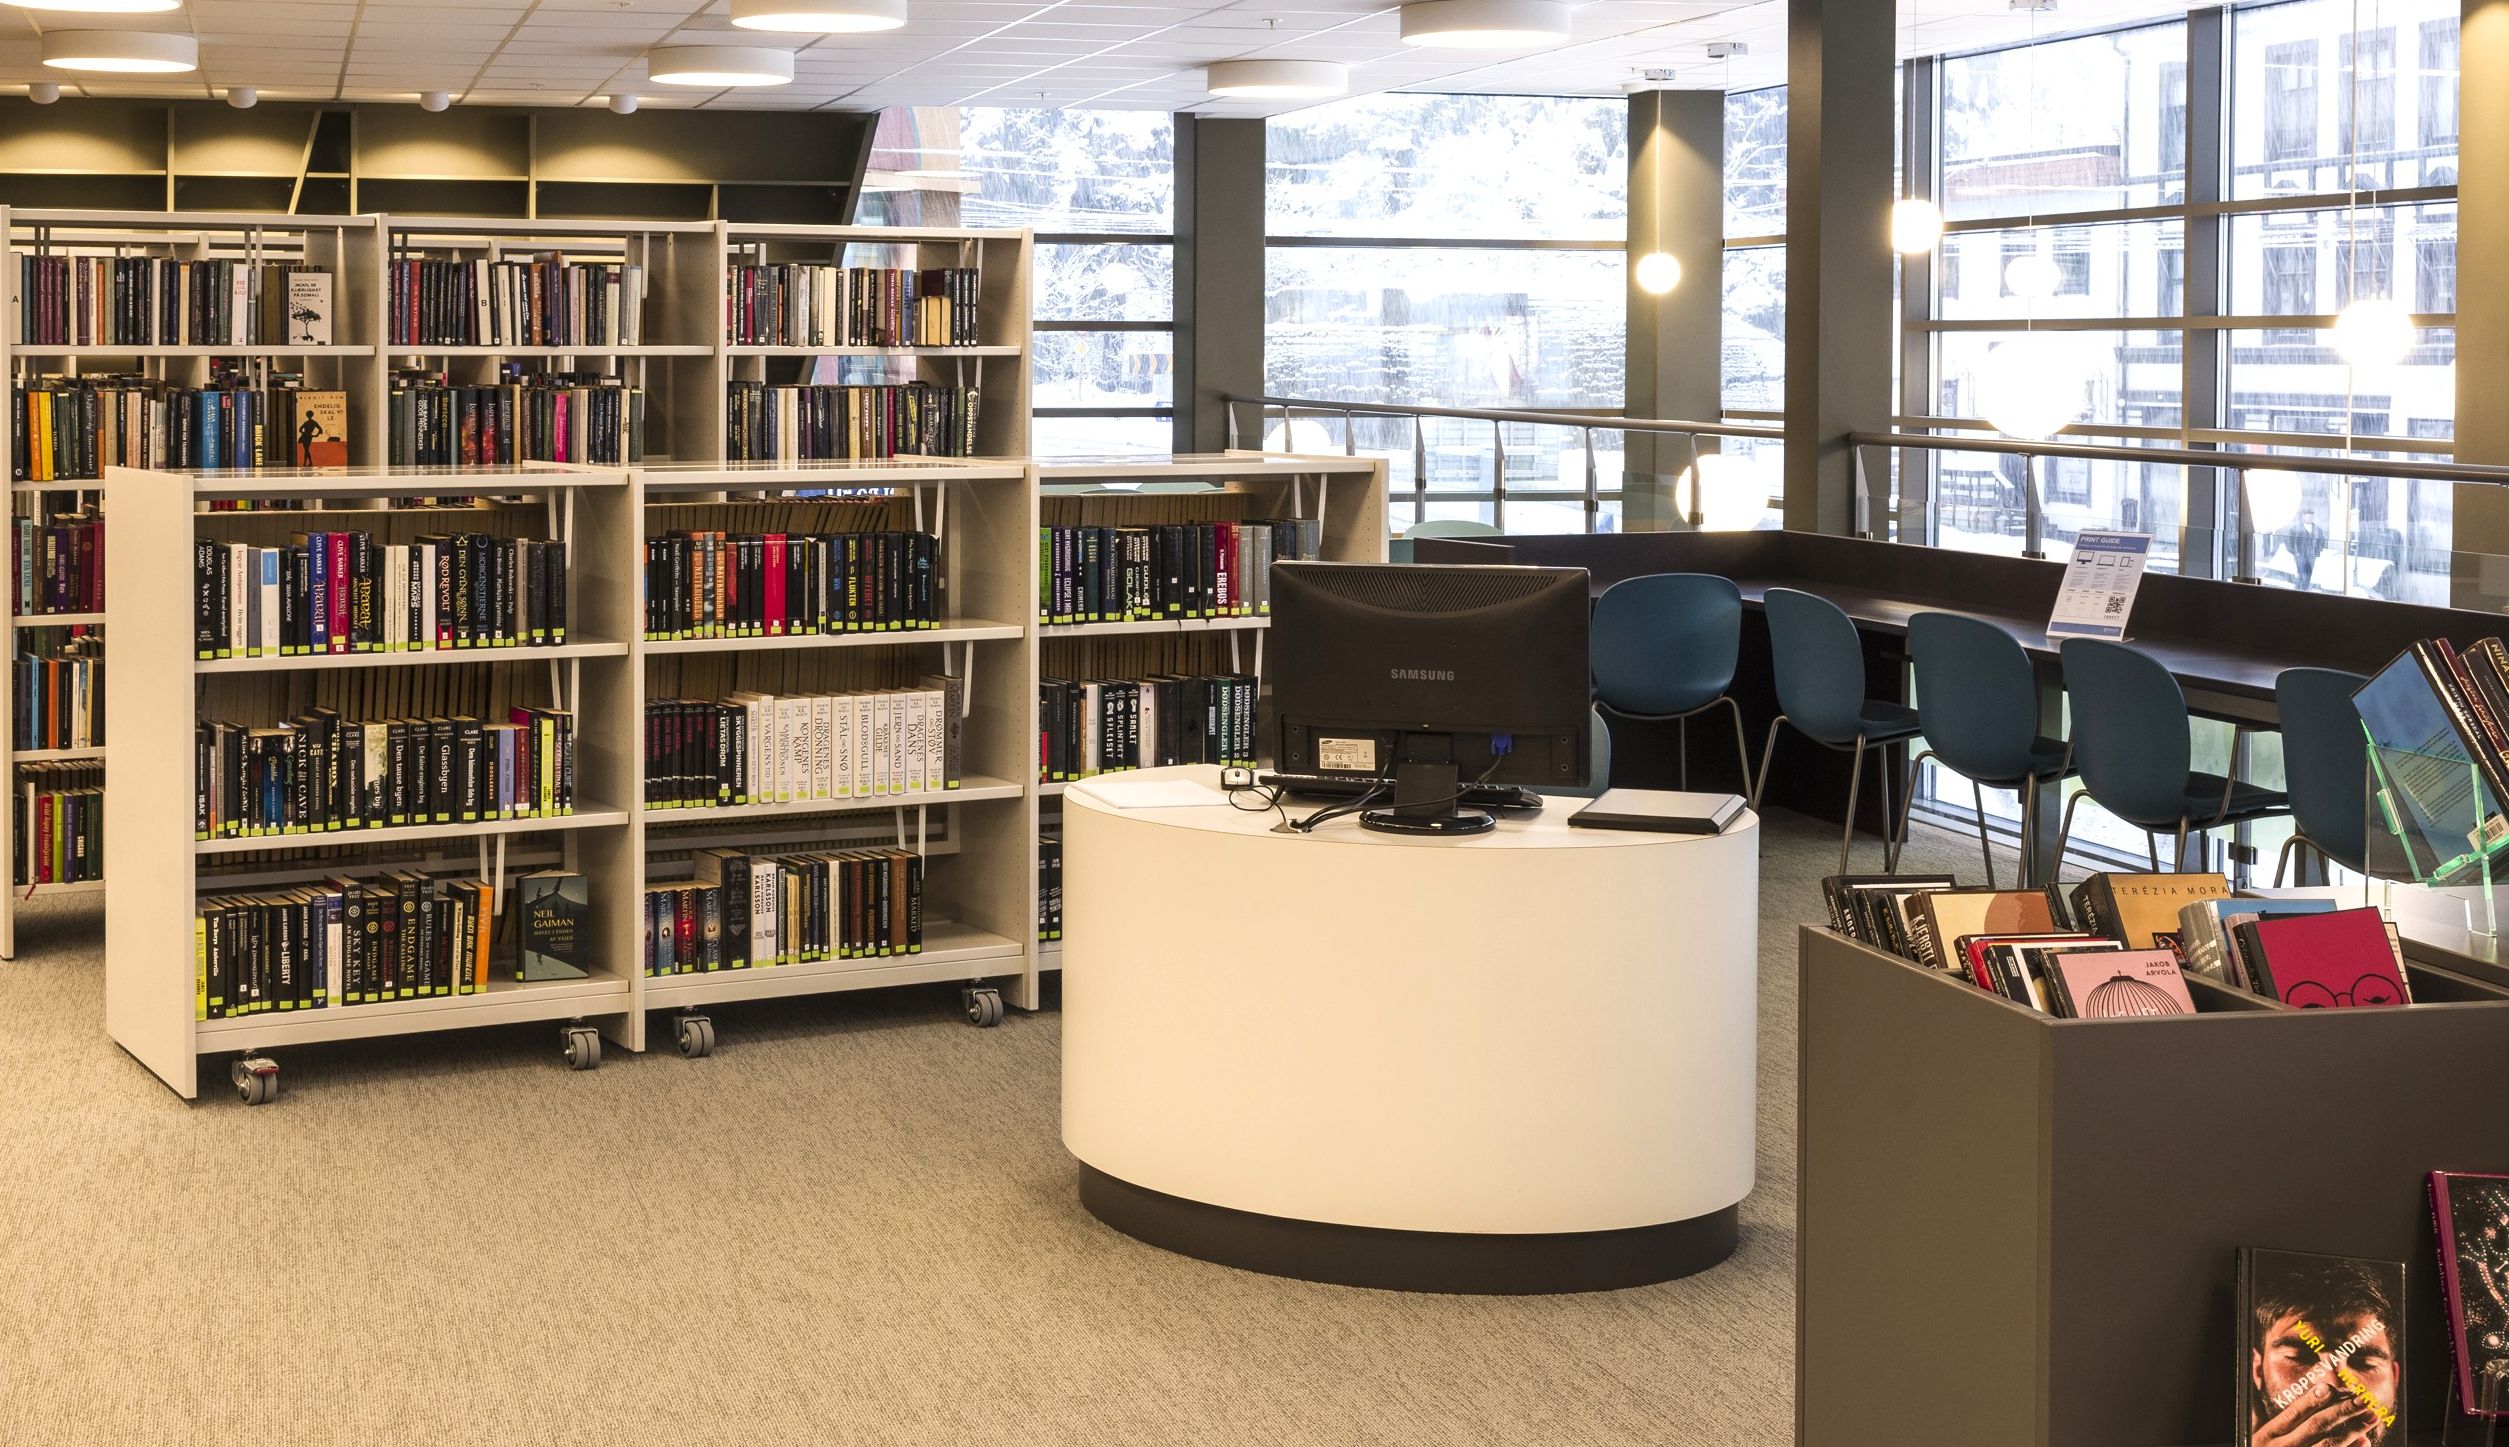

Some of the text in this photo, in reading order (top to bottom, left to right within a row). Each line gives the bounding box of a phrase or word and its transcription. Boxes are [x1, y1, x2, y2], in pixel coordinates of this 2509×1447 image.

[359, 534, 367, 573] CLIVE BARKER
[439, 554, 450, 572] RØD
[458, 549, 467, 568] DEN
[440, 573, 450, 613] REVOLT
[848, 575, 858, 607] FLUKTEN
[1126, 567, 1134, 610] GOLAK
[1216, 572, 1228, 605] EREBOS
[1390, 667, 1455, 682] SAMSUNG
[2491, 643, 2509, 673] NINA
[839, 715, 850, 739] STÅL
[893, 712, 902, 734] JERN
[1128, 714, 1137, 745] SAMLET
[1221, 686, 1230, 752] DØDSENGLER
[1233, 686, 1242, 751] DØDSENGLER
[1243, 684, 1251, 750] DØDSENGLER
[396, 745, 404, 761] Den
[764, 723, 772, 766] VARGENS
[793, 736, 803, 764] KAMP
[800, 722, 810, 774] KONGENES
[822, 721, 830, 770] DRAGENES
[860, 714, 869, 771] BLOD GULL
[875, 727, 883, 754] GILDE
[907, 723, 918, 755] DANS
[916, 714, 925, 763] DRAGENES
[928, 728, 936, 755] STØV
[934, 710, 943, 764] DRØMMER
[438, 743, 451, 794] Glassbyen
[839, 748, 848, 772] SNØ
[894, 743, 902, 769] SAND
[298, 733, 307, 819] NICK CAVE
[564, 767, 572, 788] CURE
[394, 785, 404, 807] byen
[2112, 886, 2230, 895] TERÉZIA MORA
[533, 909, 554, 919] NEIL
[533, 918, 574, 929] GAIMAN
[2083, 894, 2098, 934] TERÉZIA
[407, 917, 416, 983] ENDGAME
[1911, 913, 1936, 962] KJERSTI
[281, 951, 291, 985] LIBERTY
[352, 930, 361, 984] SKY KEY
[2295, 1320, 2325, 1353] YURI
[2273, 1319, 2386, 1409] KROPPSVANDRING
[2337, 1367, 2397, 1427] HERRERA
